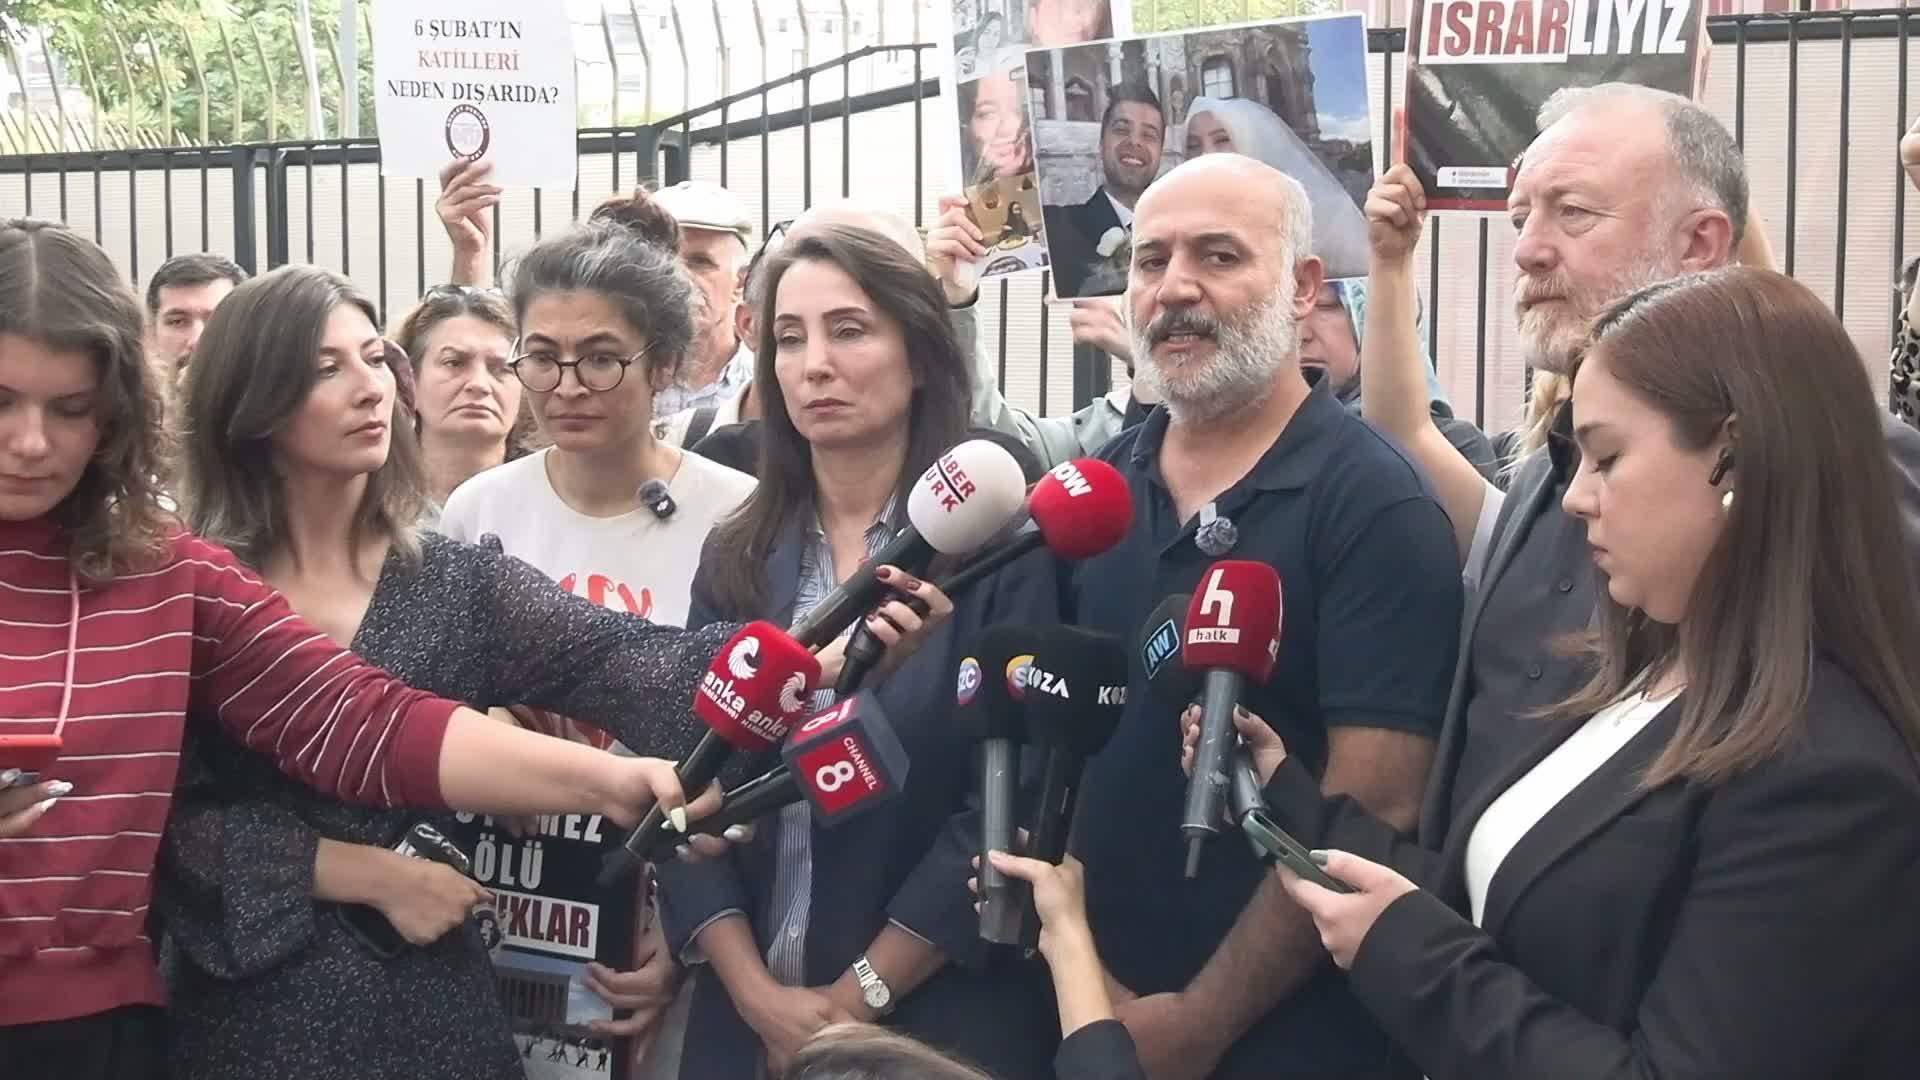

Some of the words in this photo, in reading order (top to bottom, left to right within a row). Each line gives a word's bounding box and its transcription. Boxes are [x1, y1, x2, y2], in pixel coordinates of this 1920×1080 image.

[414, 19, 423, 36] 6
[429, 20, 521, 40] ŞUBAT'IN
[418, 49, 520, 71] KATİLLERİ
[388, 80, 444, 99] NEDEN
[452, 83, 558, 104] DIŞARIDA?
[925, 468, 958, 512] URK
[942, 454, 976, 498] ABER
[1196, 629, 1227, 641] halk
[704, 671, 745, 712] anka
[1097, 685, 1128, 705] KOZ
[815, 760, 855, 792] 8
[843, 736, 877, 790] CHANNEL
[474, 833, 543, 889] ÖLÜ
